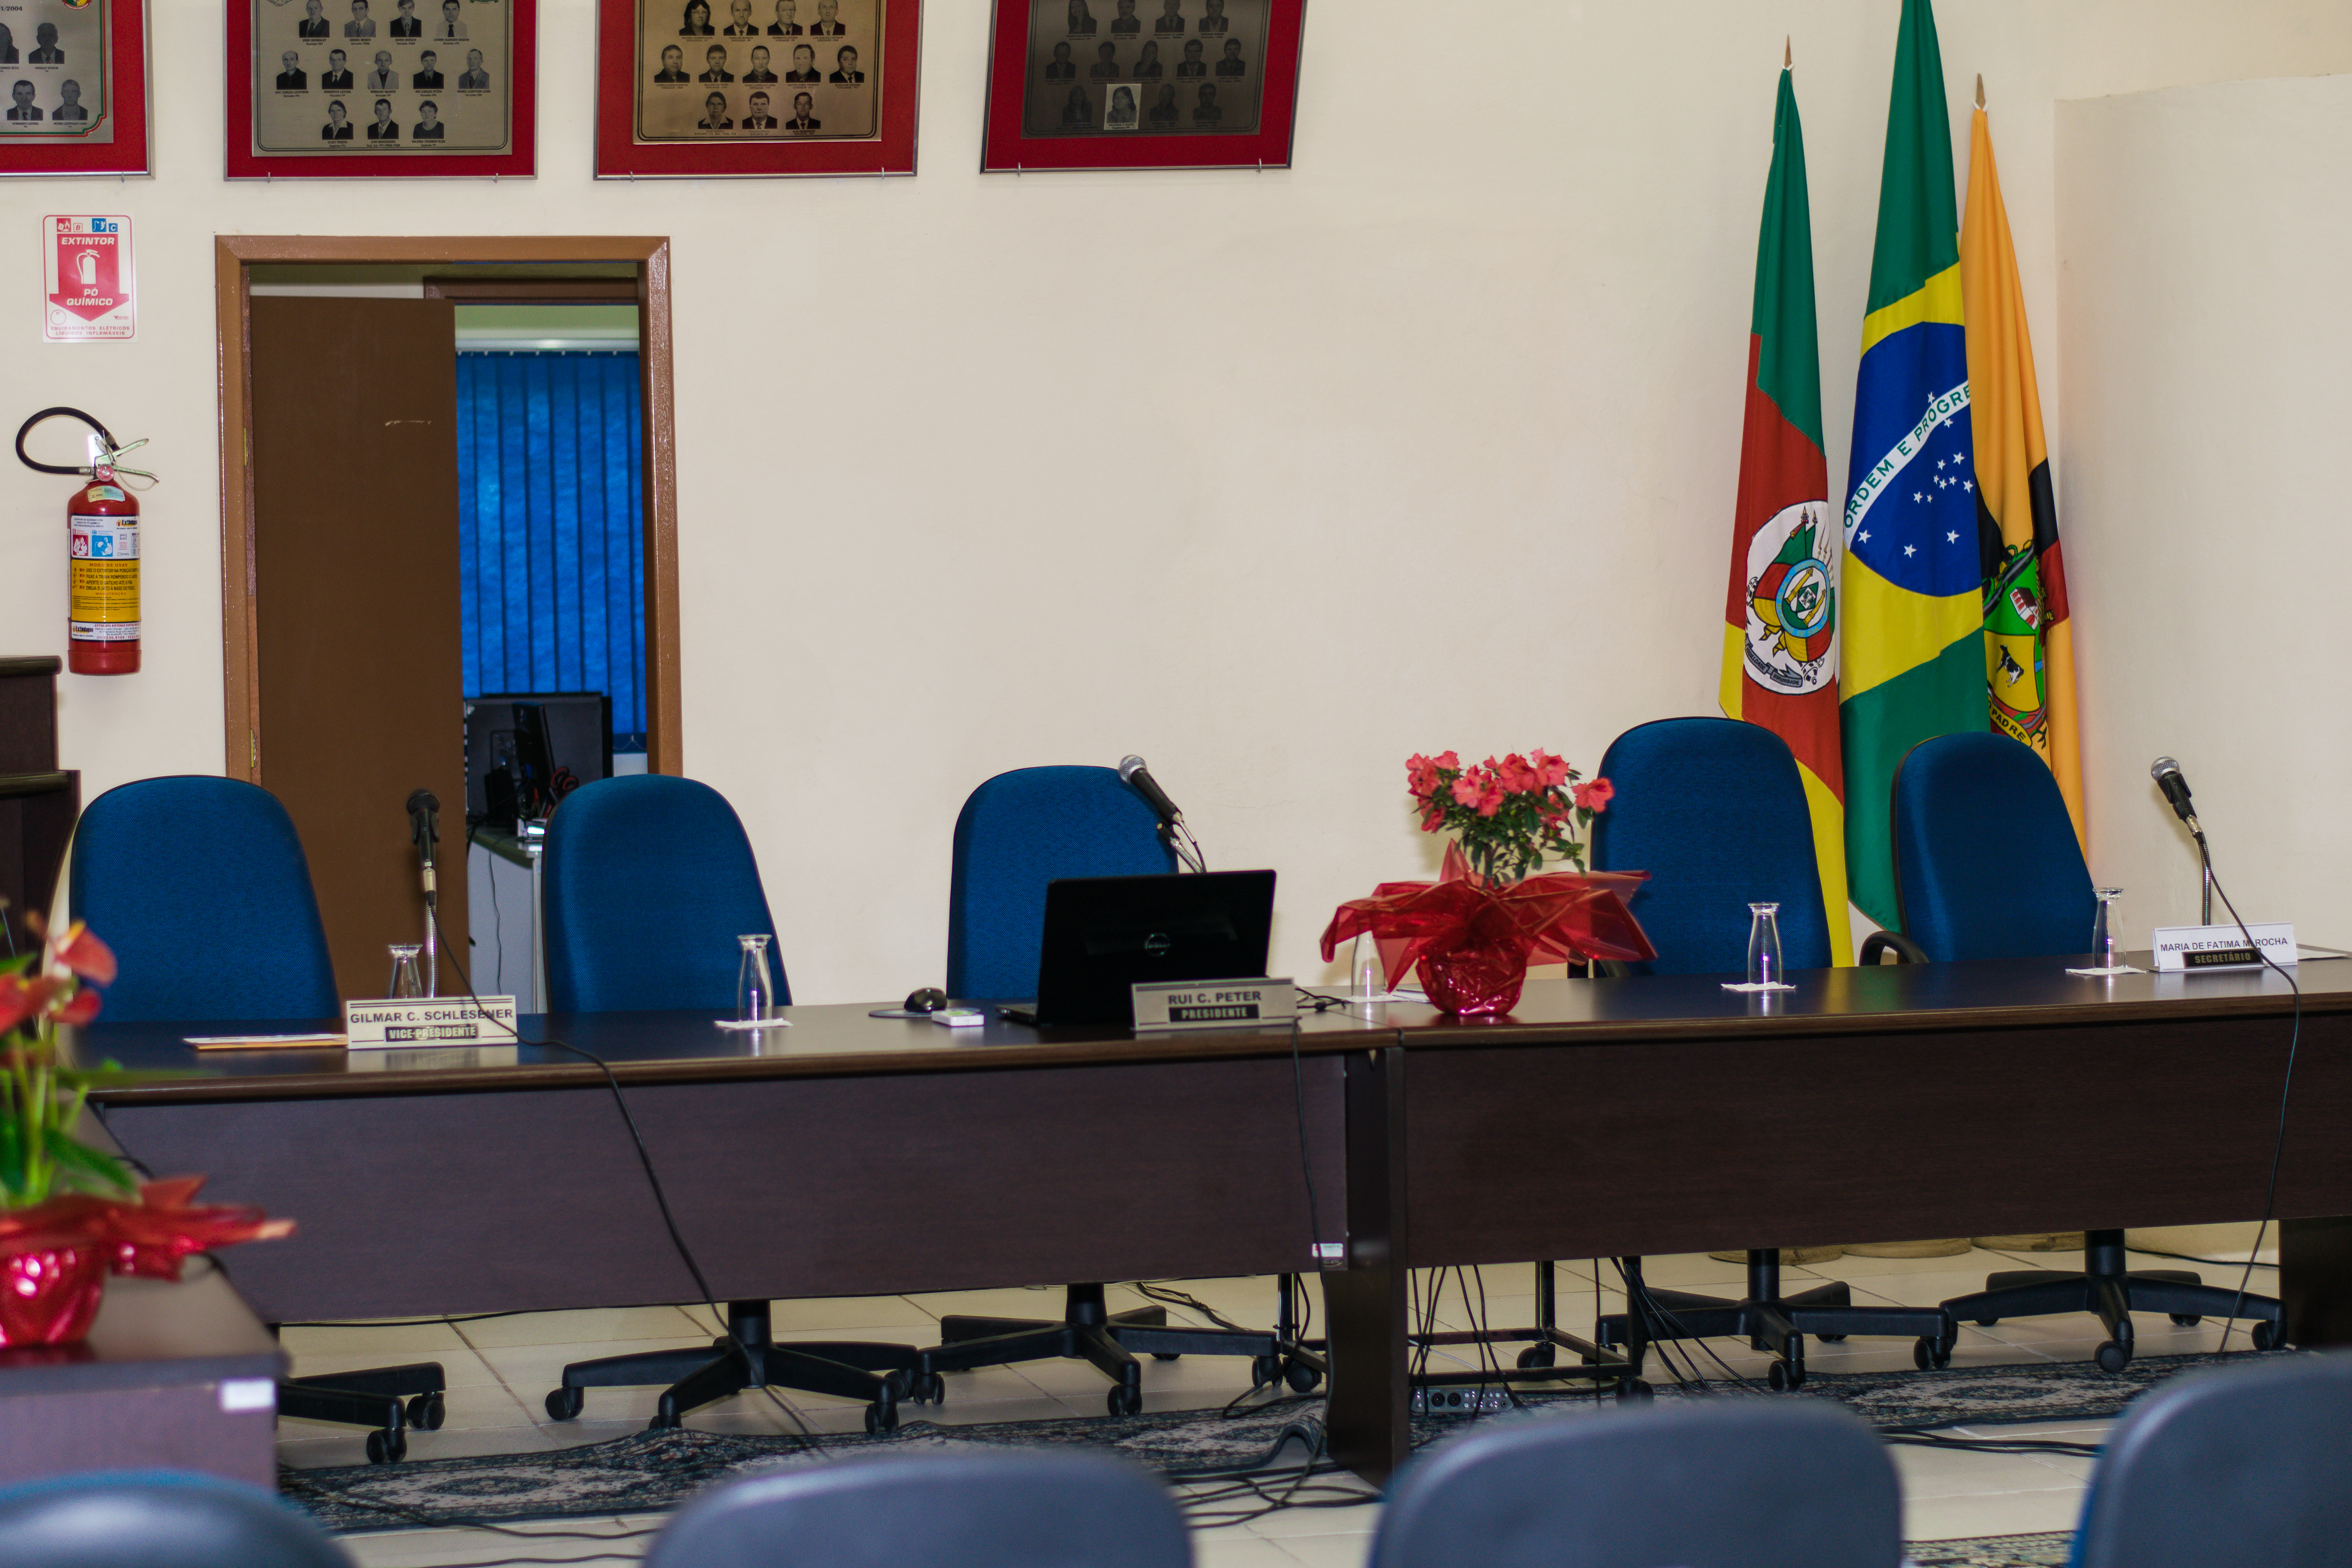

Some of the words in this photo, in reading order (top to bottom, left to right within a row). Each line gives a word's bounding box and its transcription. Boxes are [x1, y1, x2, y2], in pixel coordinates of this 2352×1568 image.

[84, 287, 98, 296] PÓ
[66, 297, 113, 306] QUÍMICO
[1844, 459, 1895, 528] ORDEM
[1897, 441, 1912, 457] E
[1914, 385, 1970, 442] PROGRE
[1746, 647, 1766, 671] IGUALDADE
[1991, 708, 2026, 742] PADRE
[2207, 940, 2240, 949] FATIMA
[2255, 937, 2288, 947] ROCHA
[2194, 952, 2251, 964] SECRETÁRIO
[1168, 994, 1192, 1005] RUI
[1197, 993, 1212, 1003] C.
[1215, 991, 1262, 1002] PETER
[350, 1012, 403, 1023] GILMAR
[407, 1012, 420, 1021] C.
[424, 1009, 513, 1020] SCHLESENER
[1181, 1007, 1248, 1019] PRESIDENTE
[389, 1026, 476, 1039] VICE-PRESIDENTE
